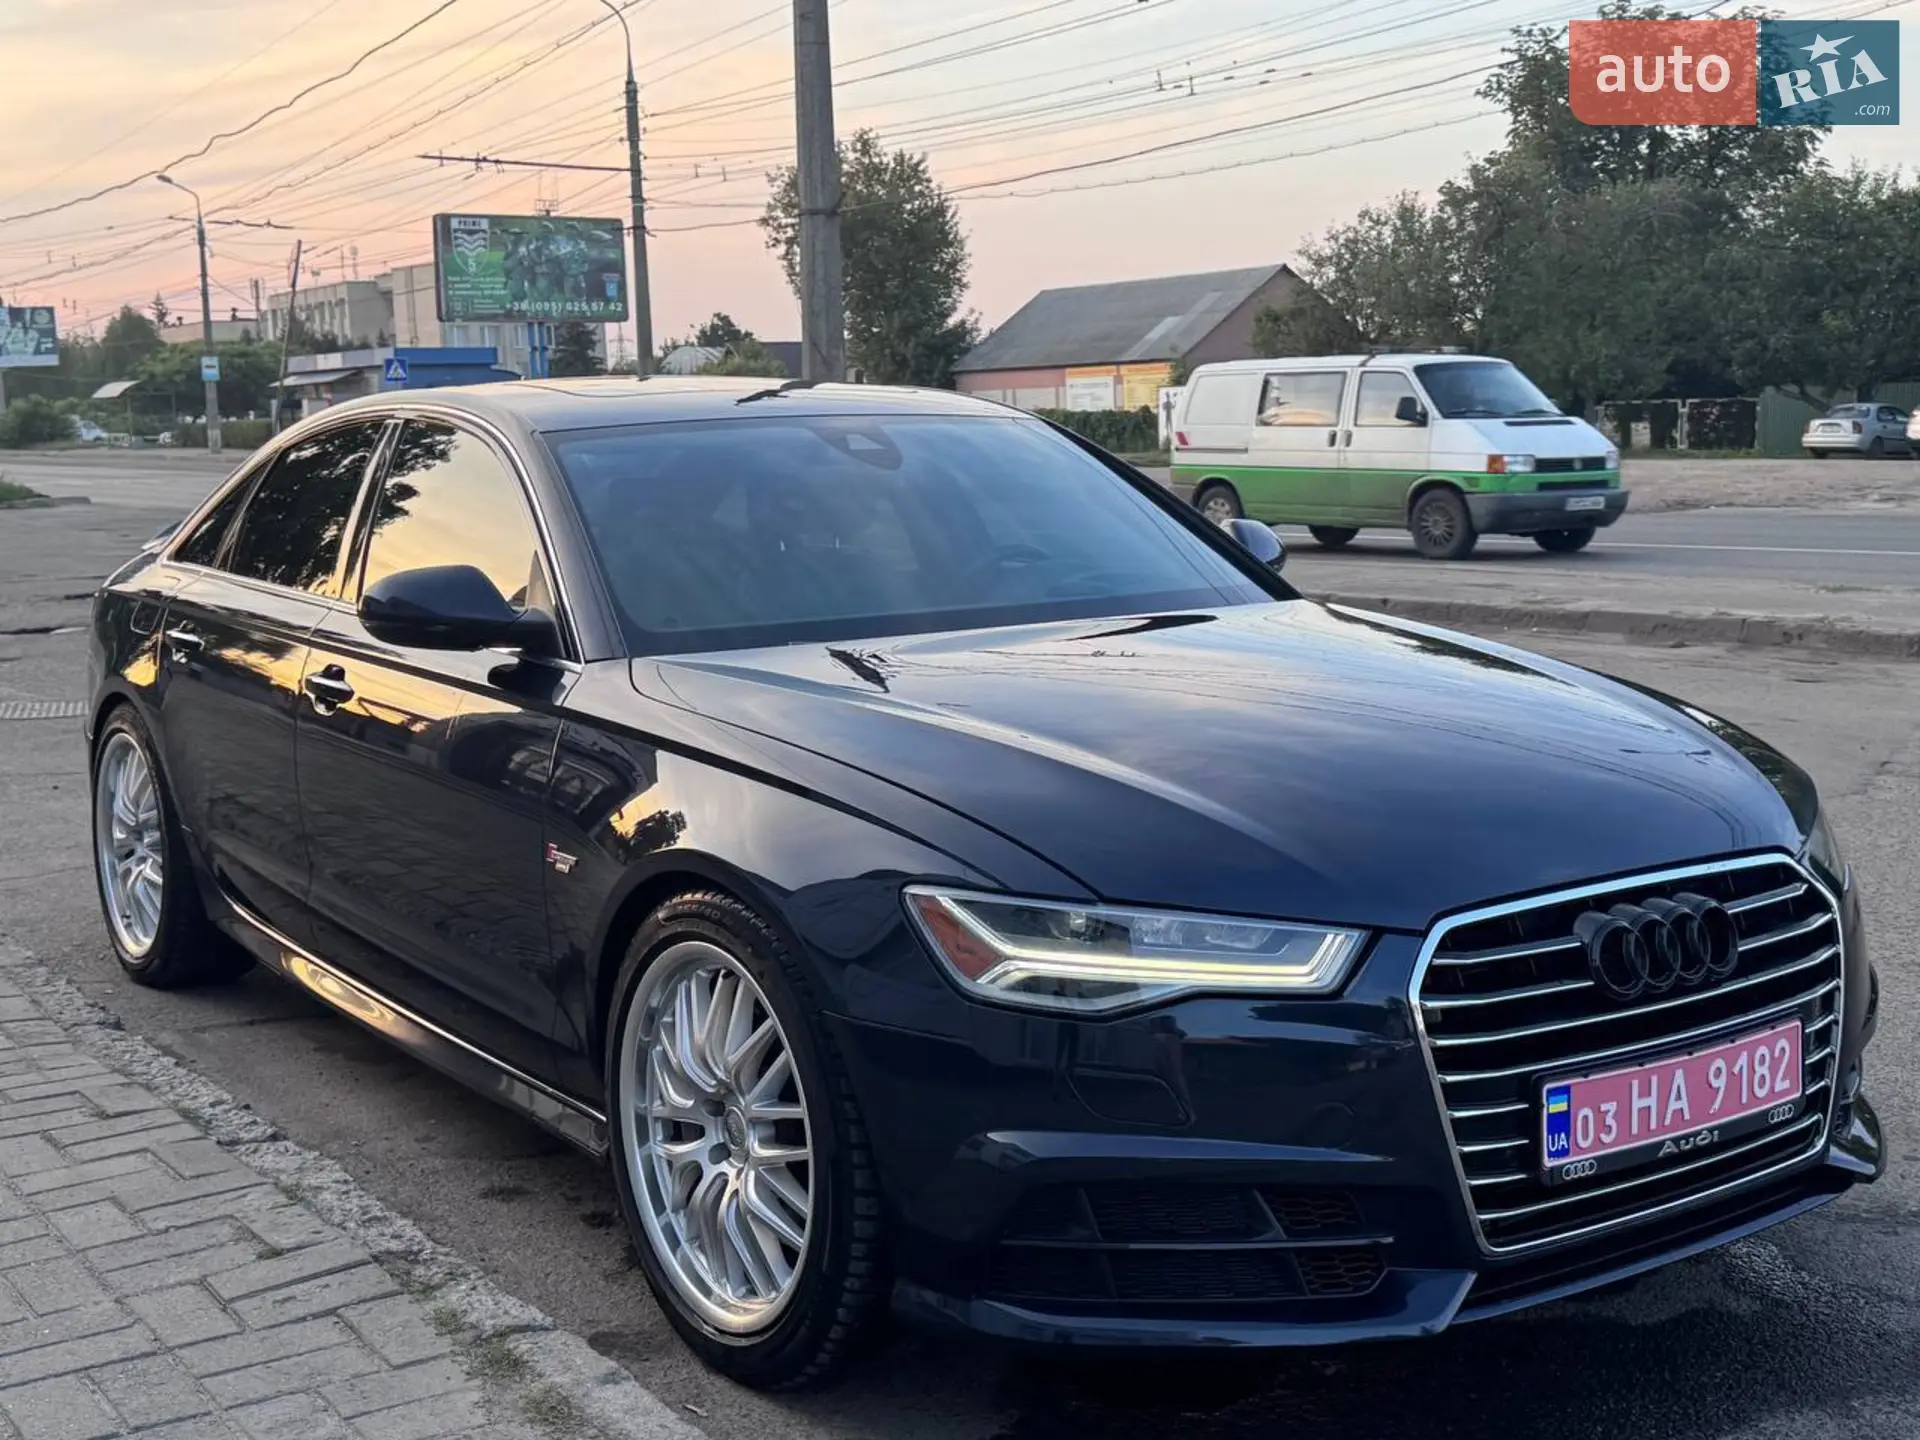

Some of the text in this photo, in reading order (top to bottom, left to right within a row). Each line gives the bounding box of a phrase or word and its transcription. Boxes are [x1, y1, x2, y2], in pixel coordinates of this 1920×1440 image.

[1575, 1037, 1791, 1149] 03 HA 9182
[1548, 1132, 1569, 1152] UA
[1658, 1130, 1720, 1157] Audi
